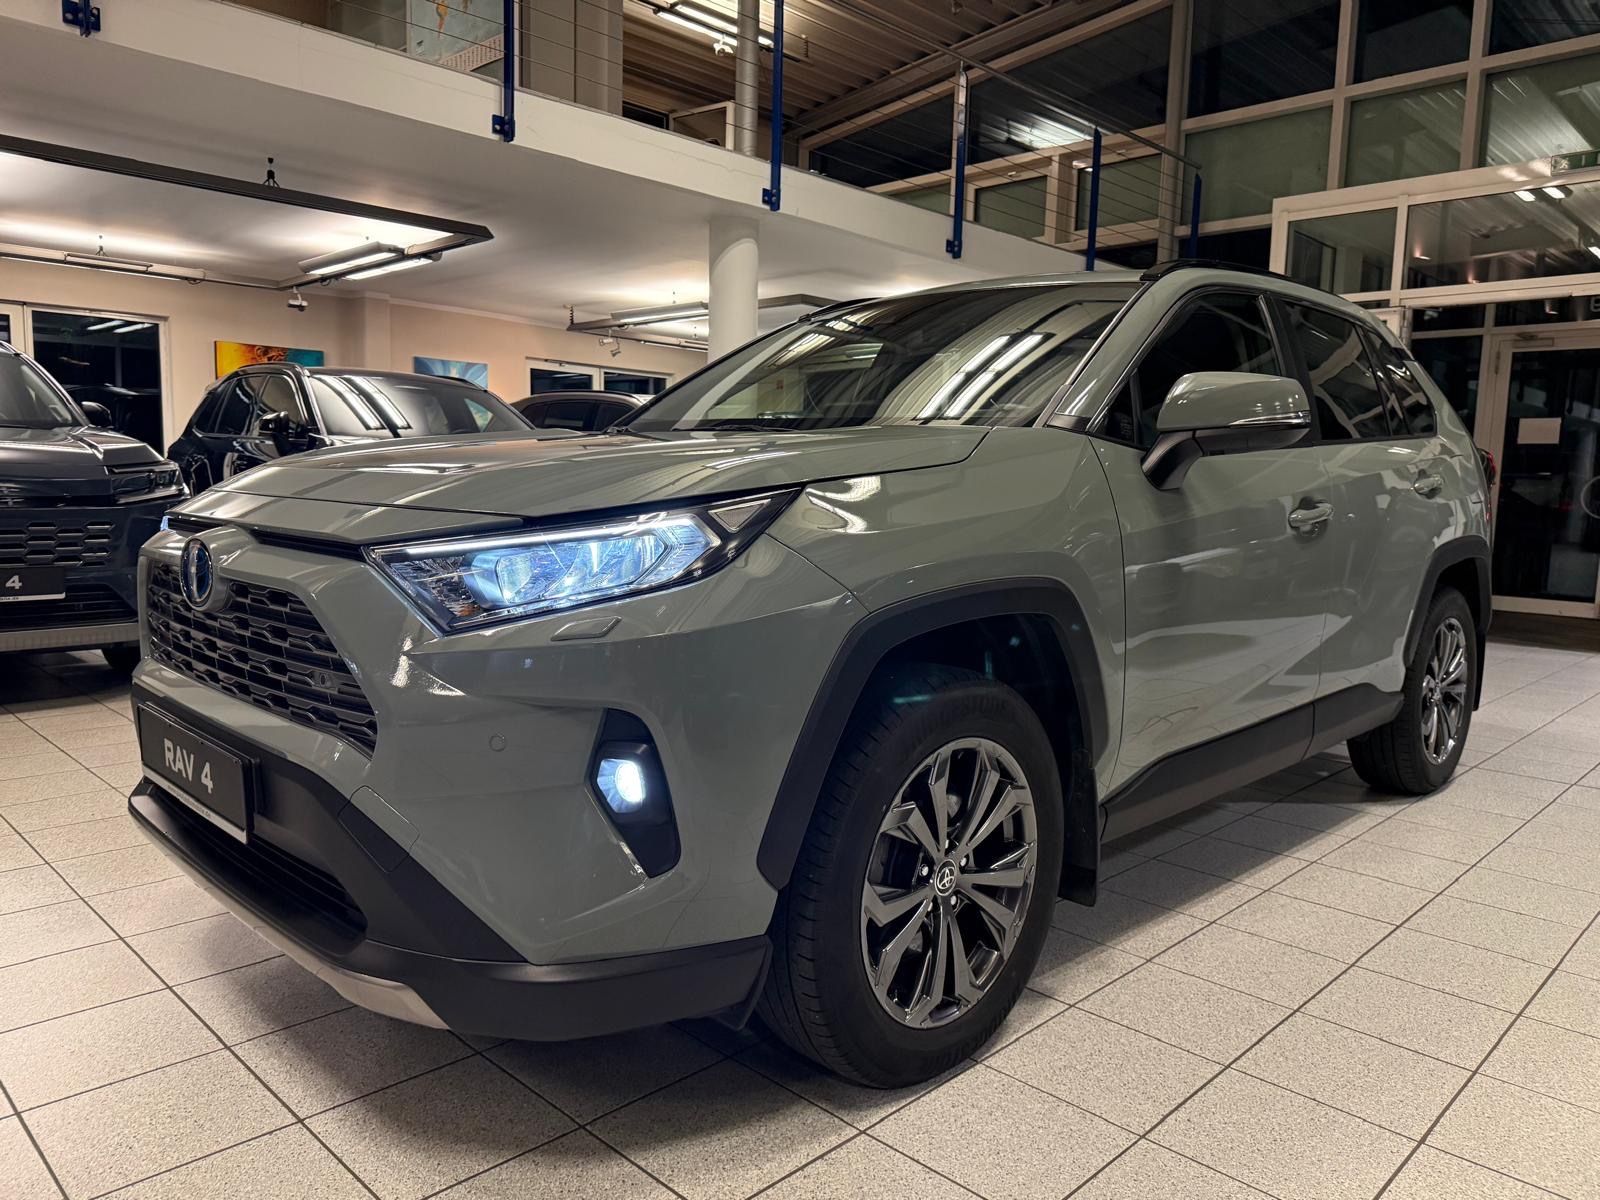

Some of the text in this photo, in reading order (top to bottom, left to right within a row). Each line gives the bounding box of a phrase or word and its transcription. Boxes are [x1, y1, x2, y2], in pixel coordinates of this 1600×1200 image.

[5, 575, 23, 590] 4
[164, 738, 214, 794] RAV 4
